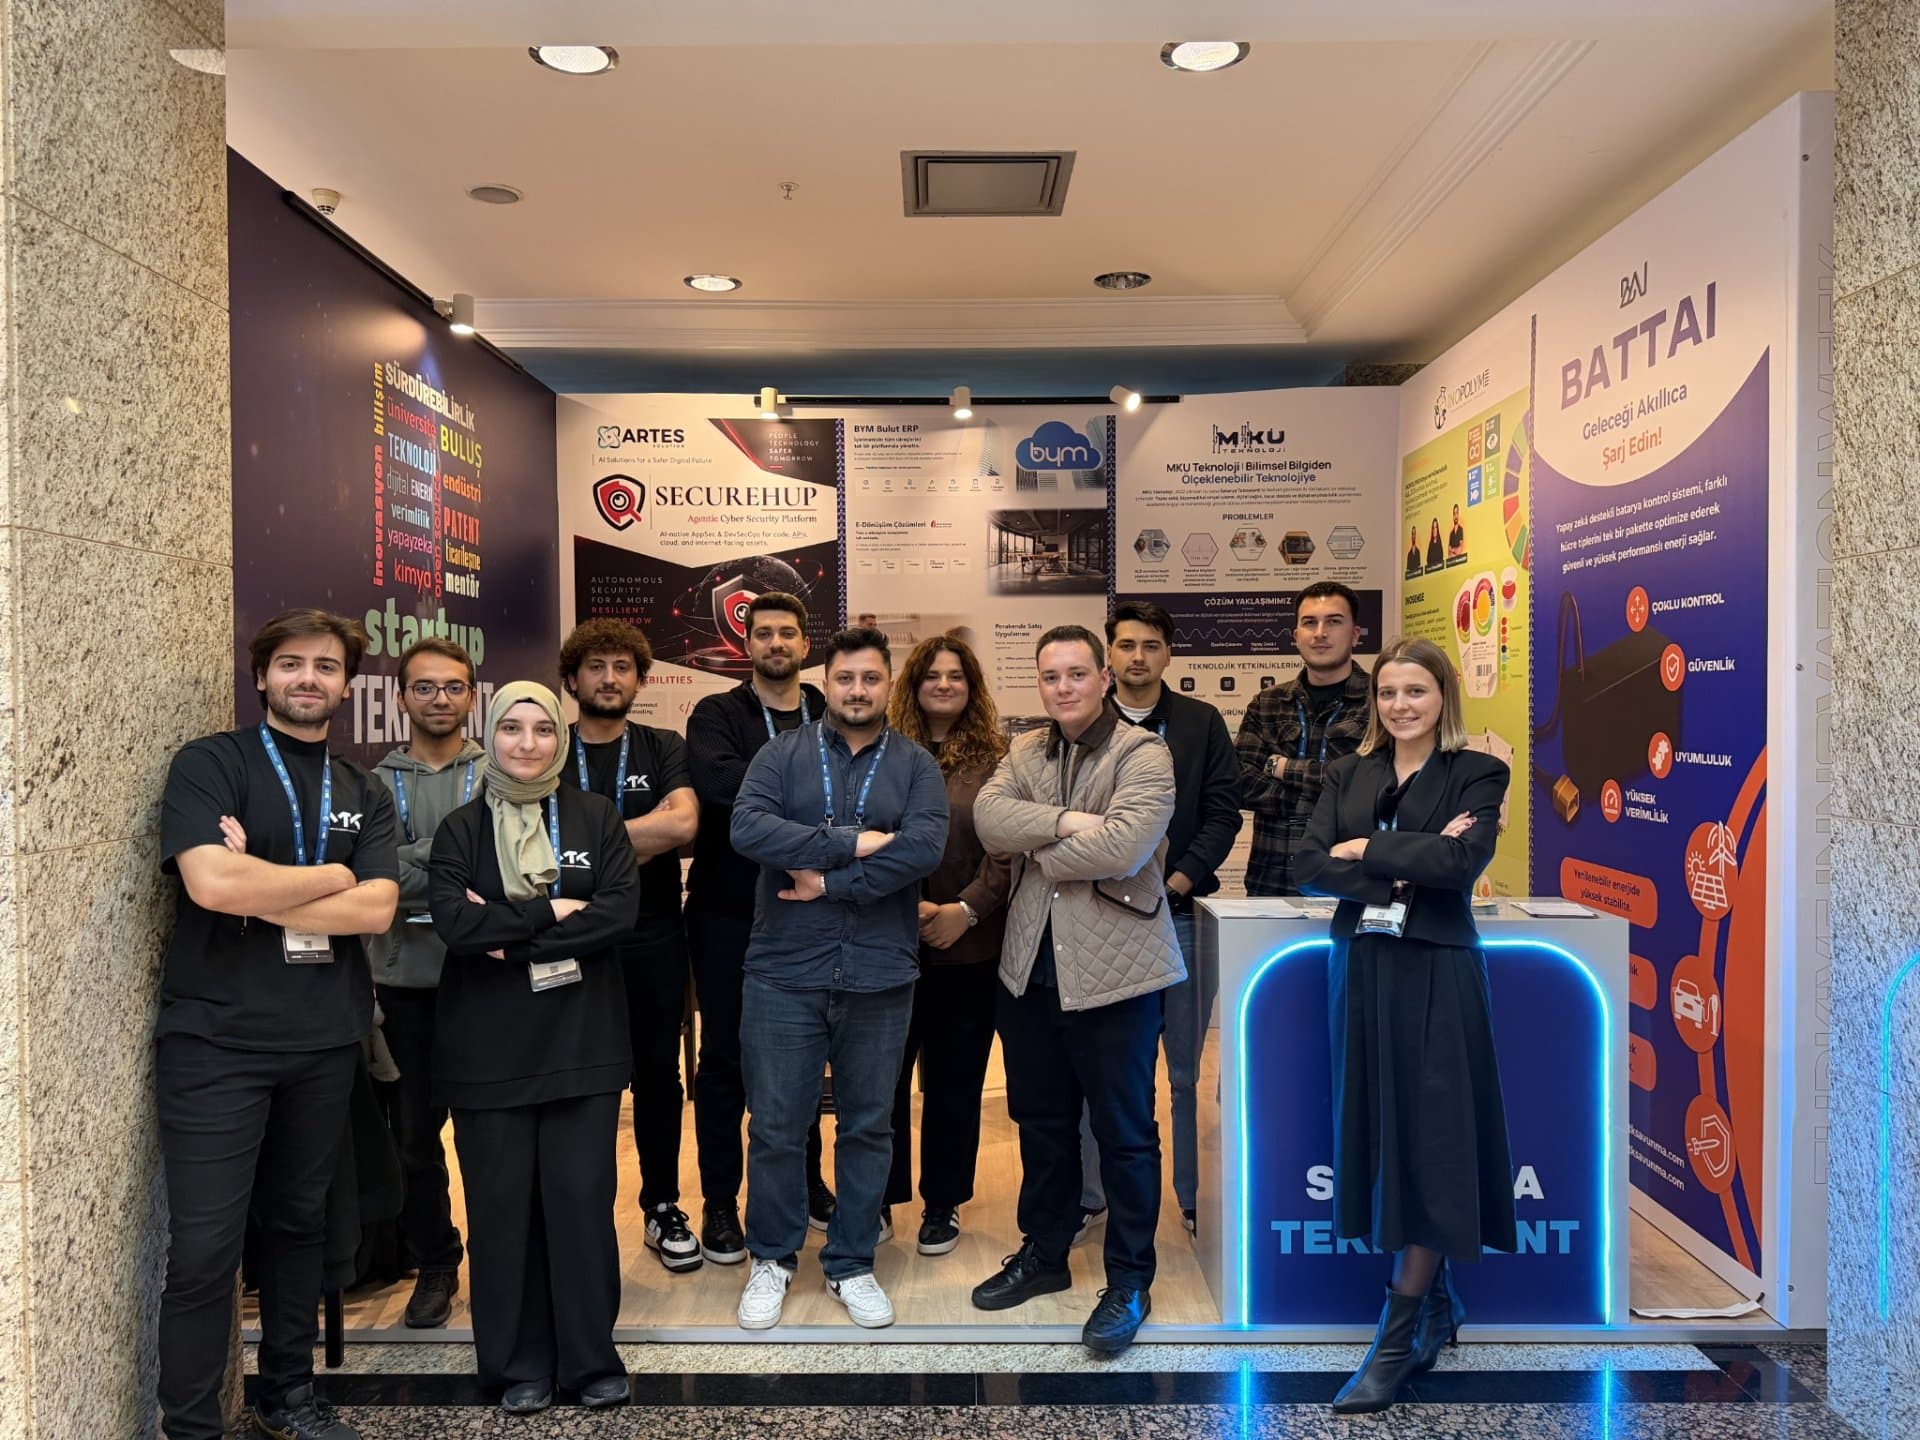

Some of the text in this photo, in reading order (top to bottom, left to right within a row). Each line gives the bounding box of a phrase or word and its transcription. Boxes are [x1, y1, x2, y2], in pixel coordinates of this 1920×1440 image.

[1561, 281, 1716, 410] BATTAI
[374, 362, 384, 436] bilişim
[385, 360, 475, 432] SÜRDÜREBİLİRLİK
[387, 396, 437, 439] üniversite
[1583, 384, 1688, 440] Geleceği Akıllıca
[622, 428, 685, 443] ARTES
[902, 424, 919, 432] ERP
[388, 431, 436, 476] TEKNOLOJİ
[440, 424, 482, 478] BULUŞ
[1030, 442, 1088, 467] bym
[1602, 426, 1662, 471] Şarj Edin!
[1166, 460, 1332, 474] MKU Teknoloji Bilimsel Bilgiden
[1181, 472, 1317, 485] Ölçeklenebilir Teknolojiye
[387, 464, 409, 496] dijital
[443, 473, 481, 504] endüstri
[655, 486, 817, 506] SECUREHUP
[1556, 522, 1574, 534] Yapay
[1589, 507, 1615, 525] destekli
[1615, 501, 1642, 517] batarya
[1643, 491, 1671, 509] kontrol
[1671, 483, 1703, 501] sistemi,
[1705, 474, 1728, 491] farklı
[373, 445, 383, 586] inovasyon
[391, 503, 430, 529] verimlilik
[443, 506, 480, 546] PATENT
[688, 513, 817, 525] Agentic Cyber Security Platform
[1222, 513, 1274, 521] PROBLEMLER
[1560, 501, 1721, 553] hücre tiplerini tek bir pakette optimize ederek
[387, 528, 433, 555] yapayzeka
[1561, 529, 1717, 574] güvenli ve yüksek performanslı enerji sağlar.
[394, 556, 432, 593] kimya
[445, 571, 480, 598] mentör
[591, 576, 663, 584] AUTONOMOUS
[591, 586, 641, 594] SECURITY
[627, 596, 656, 604] MORE
[1204, 597, 1292, 607] ÇÖZÜM YAKLAŞIMIMIZ
[1652, 593, 1725, 615] ÇOKLU KONTROL
[365, 598, 485, 667] startup
[1188, 661, 1235, 670] TEKNOLOJİK
[1688, 656, 1735, 672] GÜVENLİK
[1675, 751, 1732, 767] UYUMLULUK
[1625, 789, 1656, 805] YÜKSEK
[1625, 806, 1669, 824] VERİMLİLİK
[1580, 887, 1603, 903] yüksek
[1612, 880, 1641, 897] enerjide
